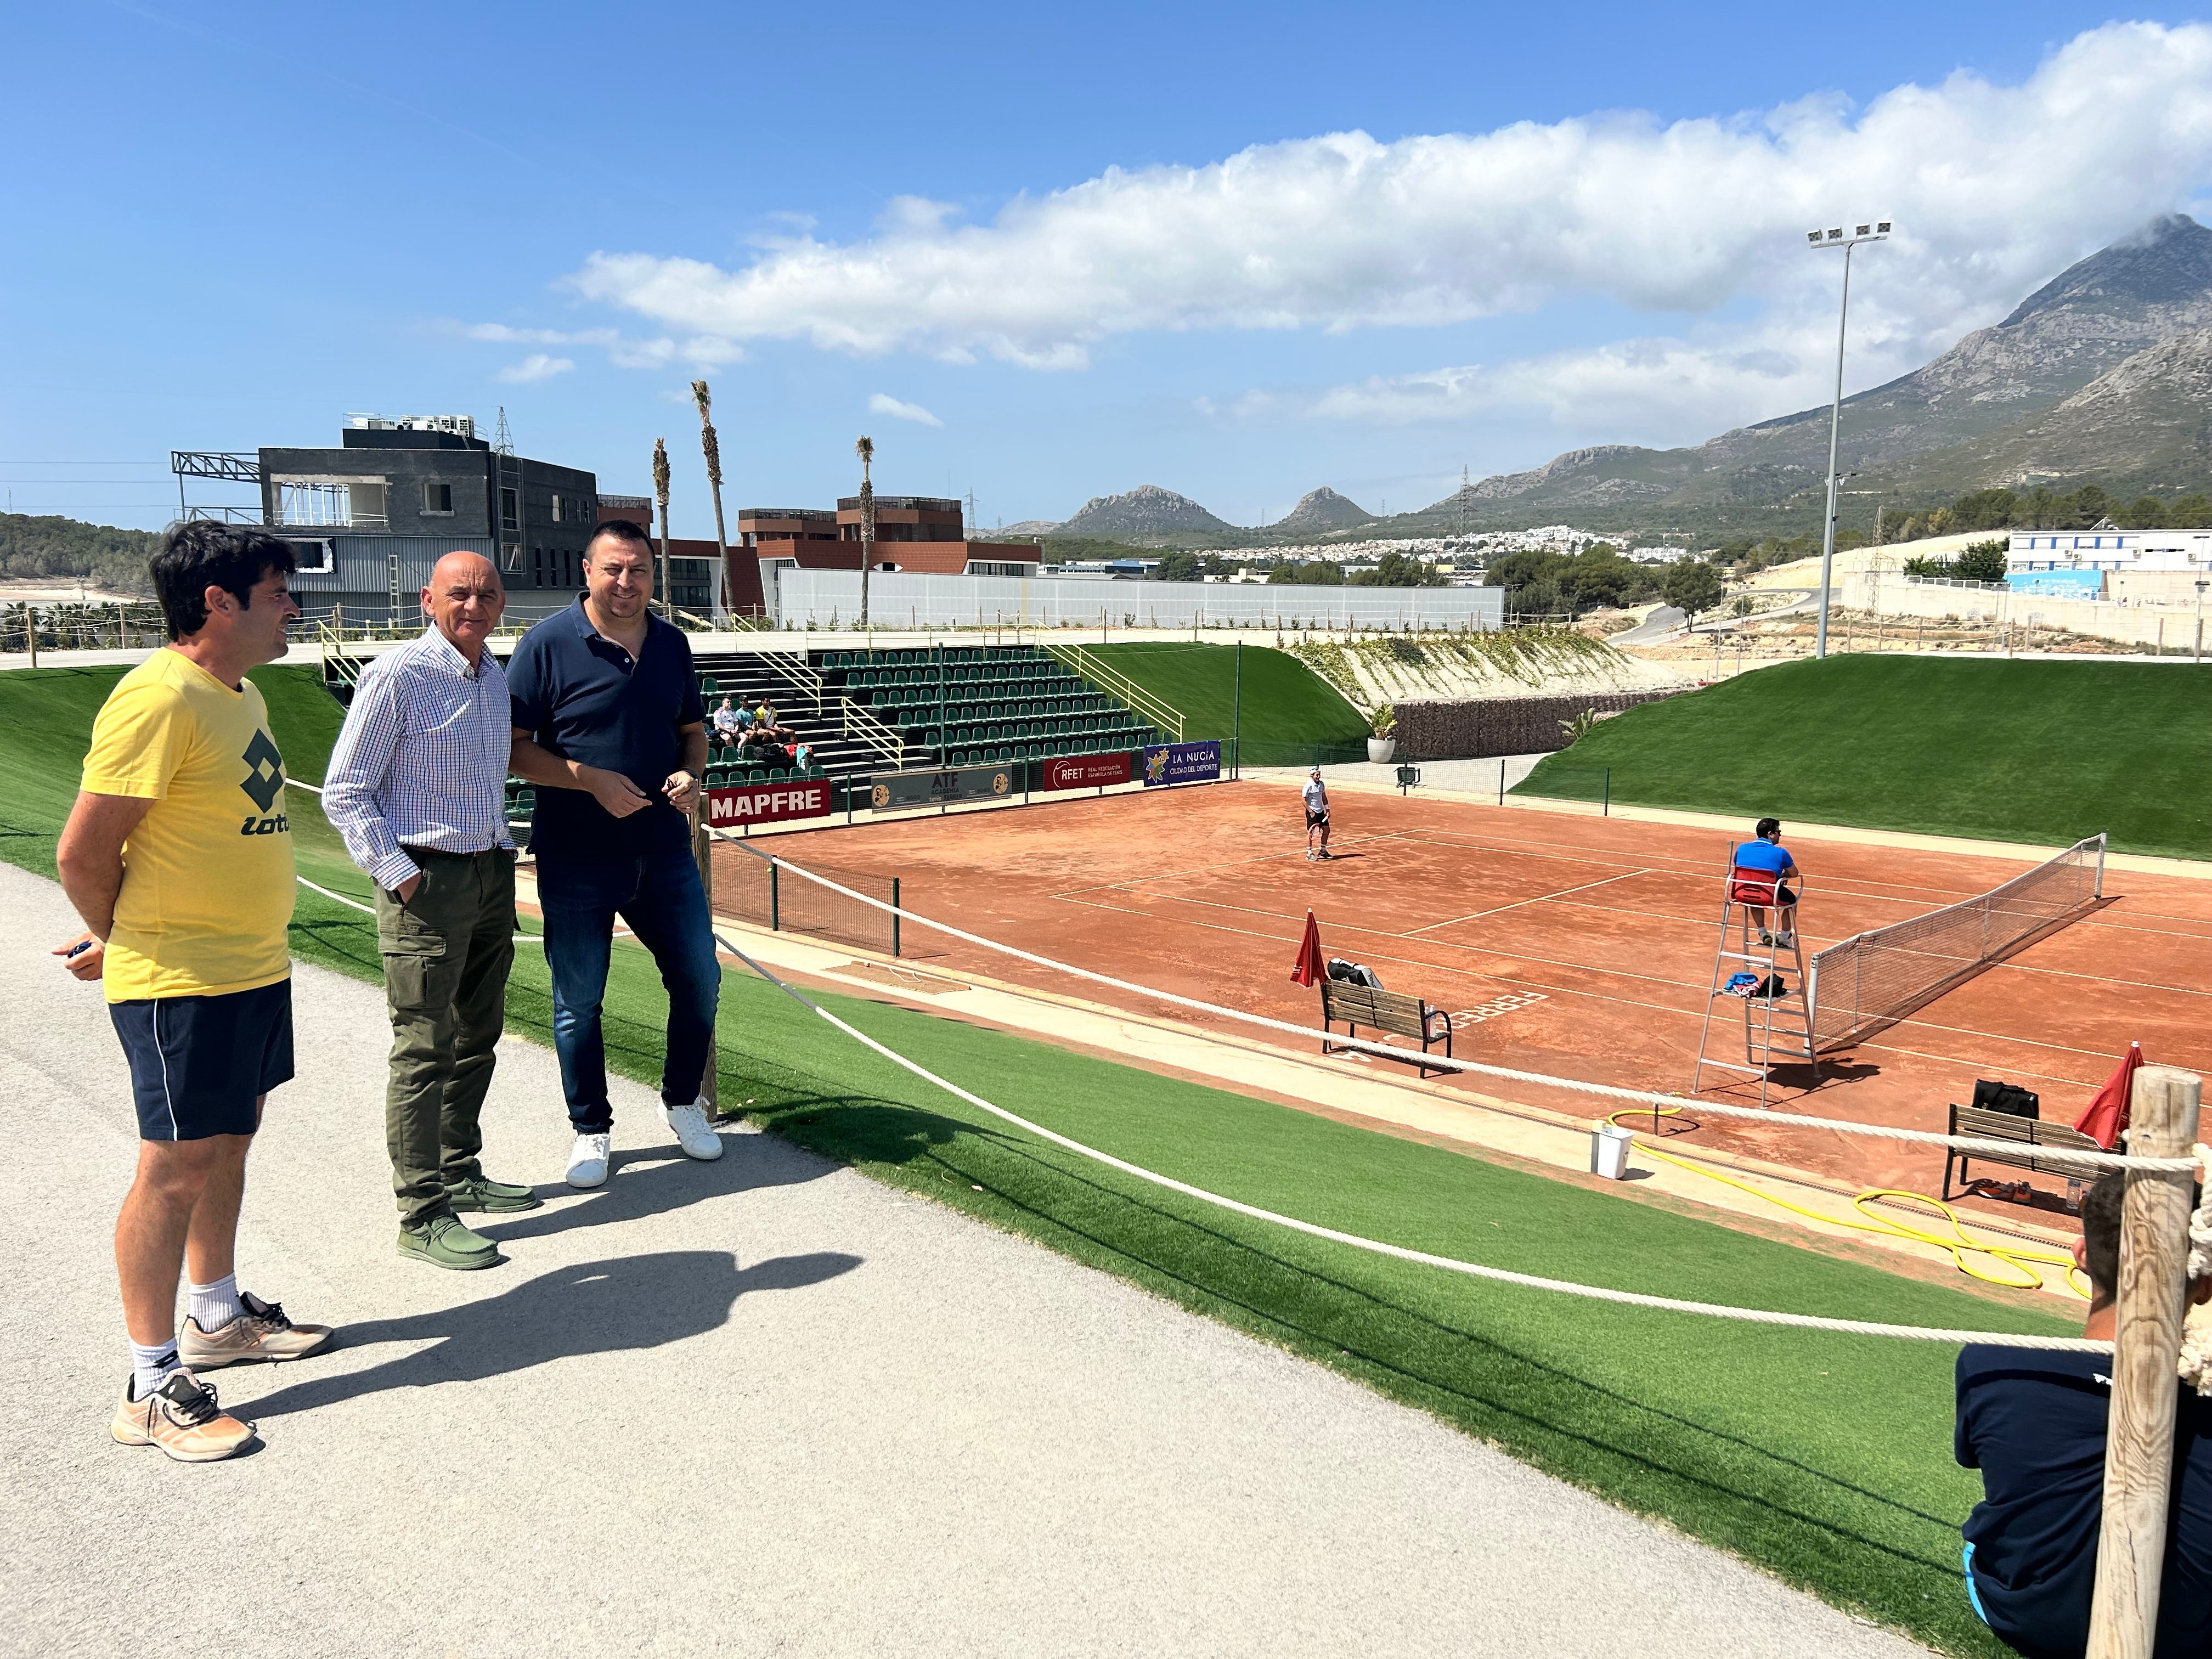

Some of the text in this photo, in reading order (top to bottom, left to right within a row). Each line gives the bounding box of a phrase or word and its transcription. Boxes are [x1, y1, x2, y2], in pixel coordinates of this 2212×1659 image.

[1173, 754, 1182, 764] LA
[1062, 768, 1084, 780] RFET
[1170, 766, 1187, 775] CIUDAD
[1197, 764, 1218, 772] DEPORTE
[932, 772, 958, 789] ATF
[711, 789, 821, 819] MAPFRE
